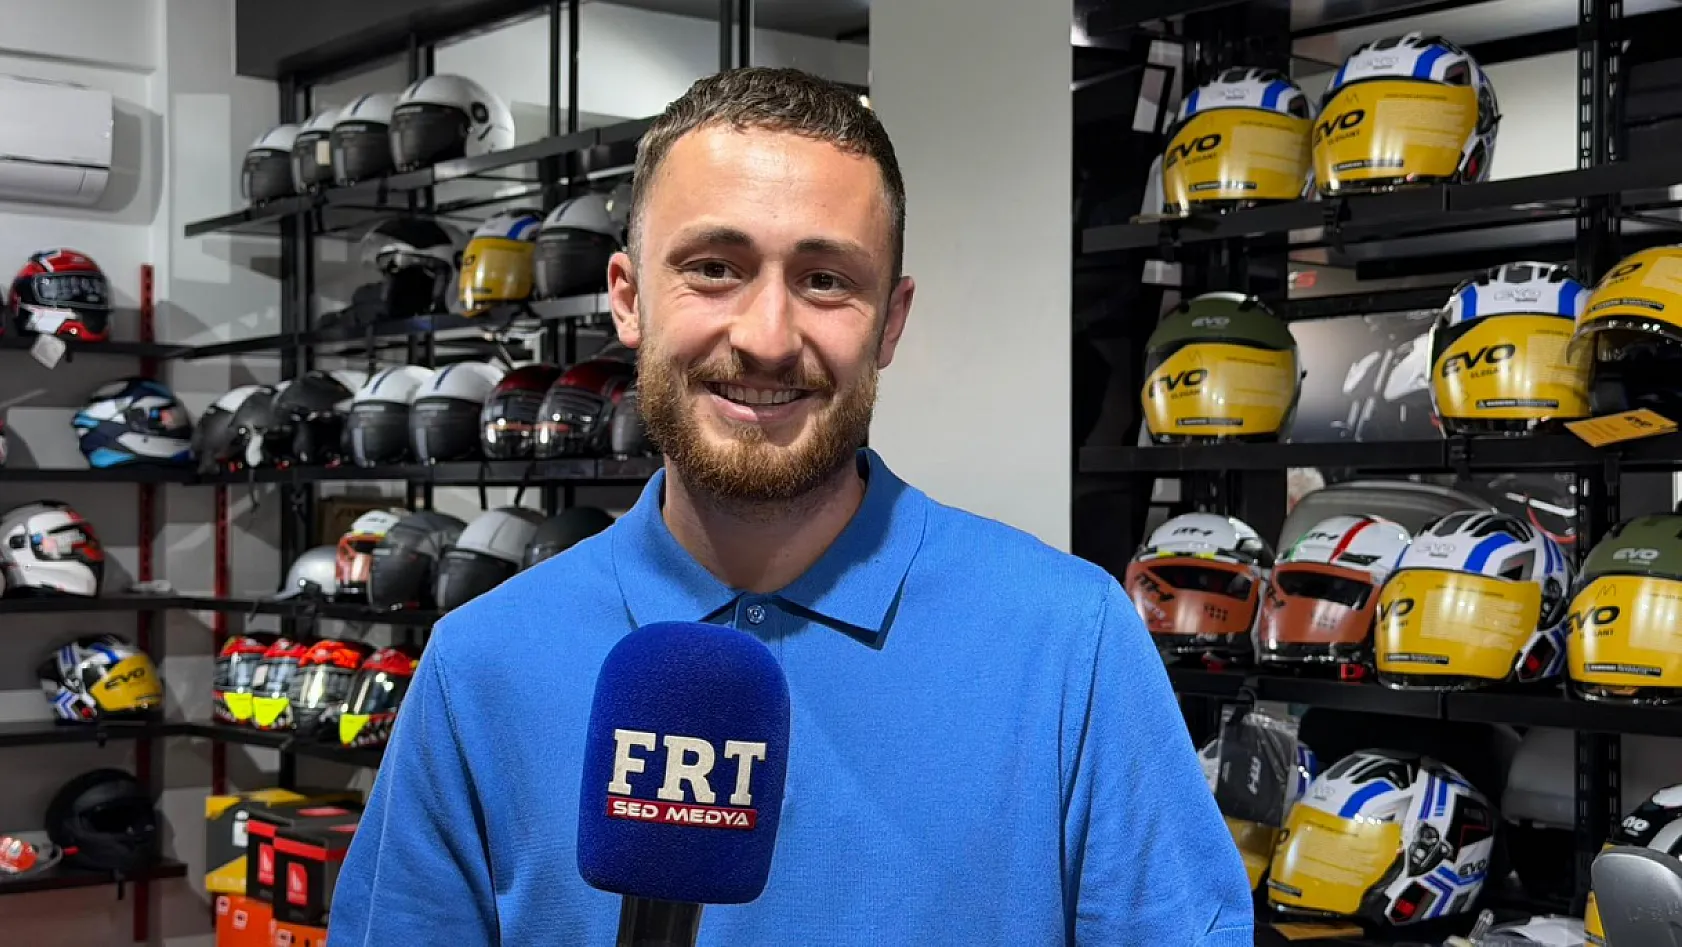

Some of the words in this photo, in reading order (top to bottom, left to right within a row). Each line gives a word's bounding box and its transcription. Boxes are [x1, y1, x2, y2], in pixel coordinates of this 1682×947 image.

[1442, 344, 1516, 378] EVO
[1380, 598, 1415, 621] VO
[608, 728, 766, 806] FRT
[613, 801, 659, 819] SED
[665, 807, 749, 827] MEDYA
